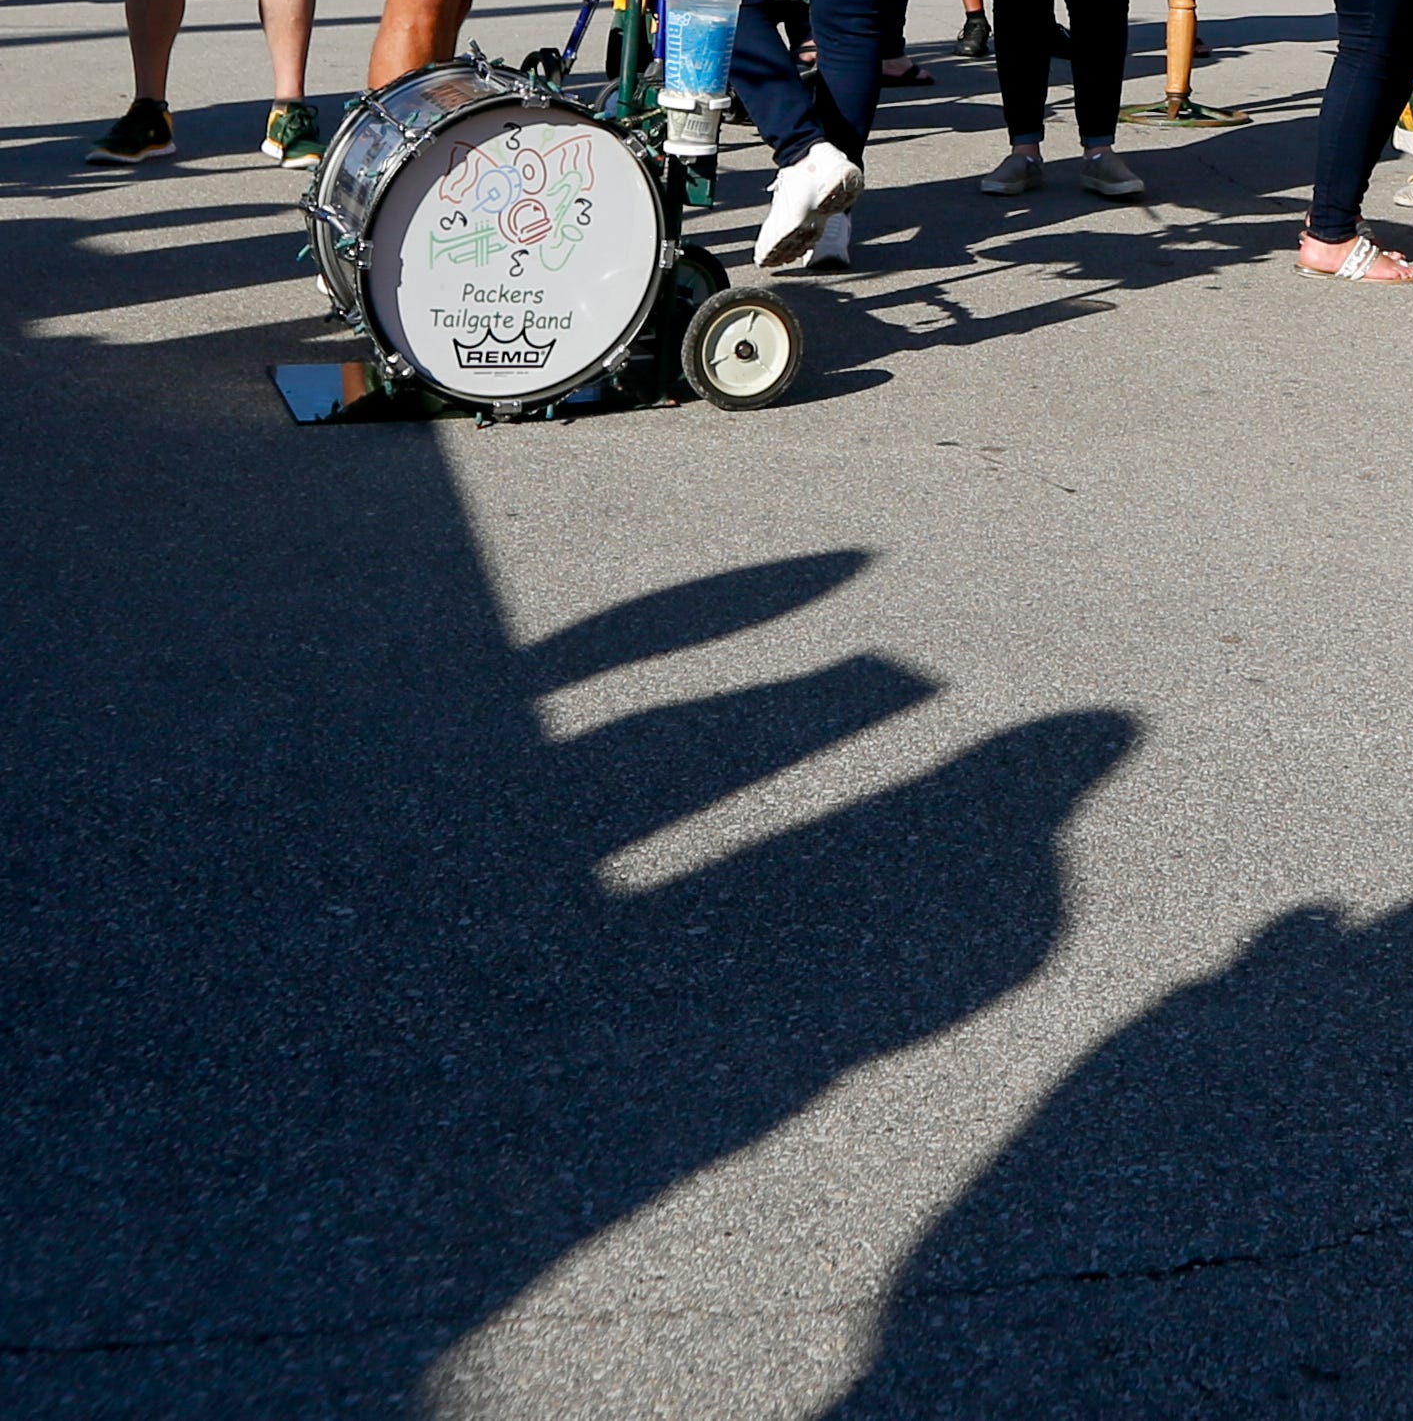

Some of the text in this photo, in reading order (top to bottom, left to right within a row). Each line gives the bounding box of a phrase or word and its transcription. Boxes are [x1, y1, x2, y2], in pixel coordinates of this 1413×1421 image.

[461, 283, 545, 305] Packers
[429, 309, 574, 334] Tailgate Band
[467, 350, 540, 363] REMO
